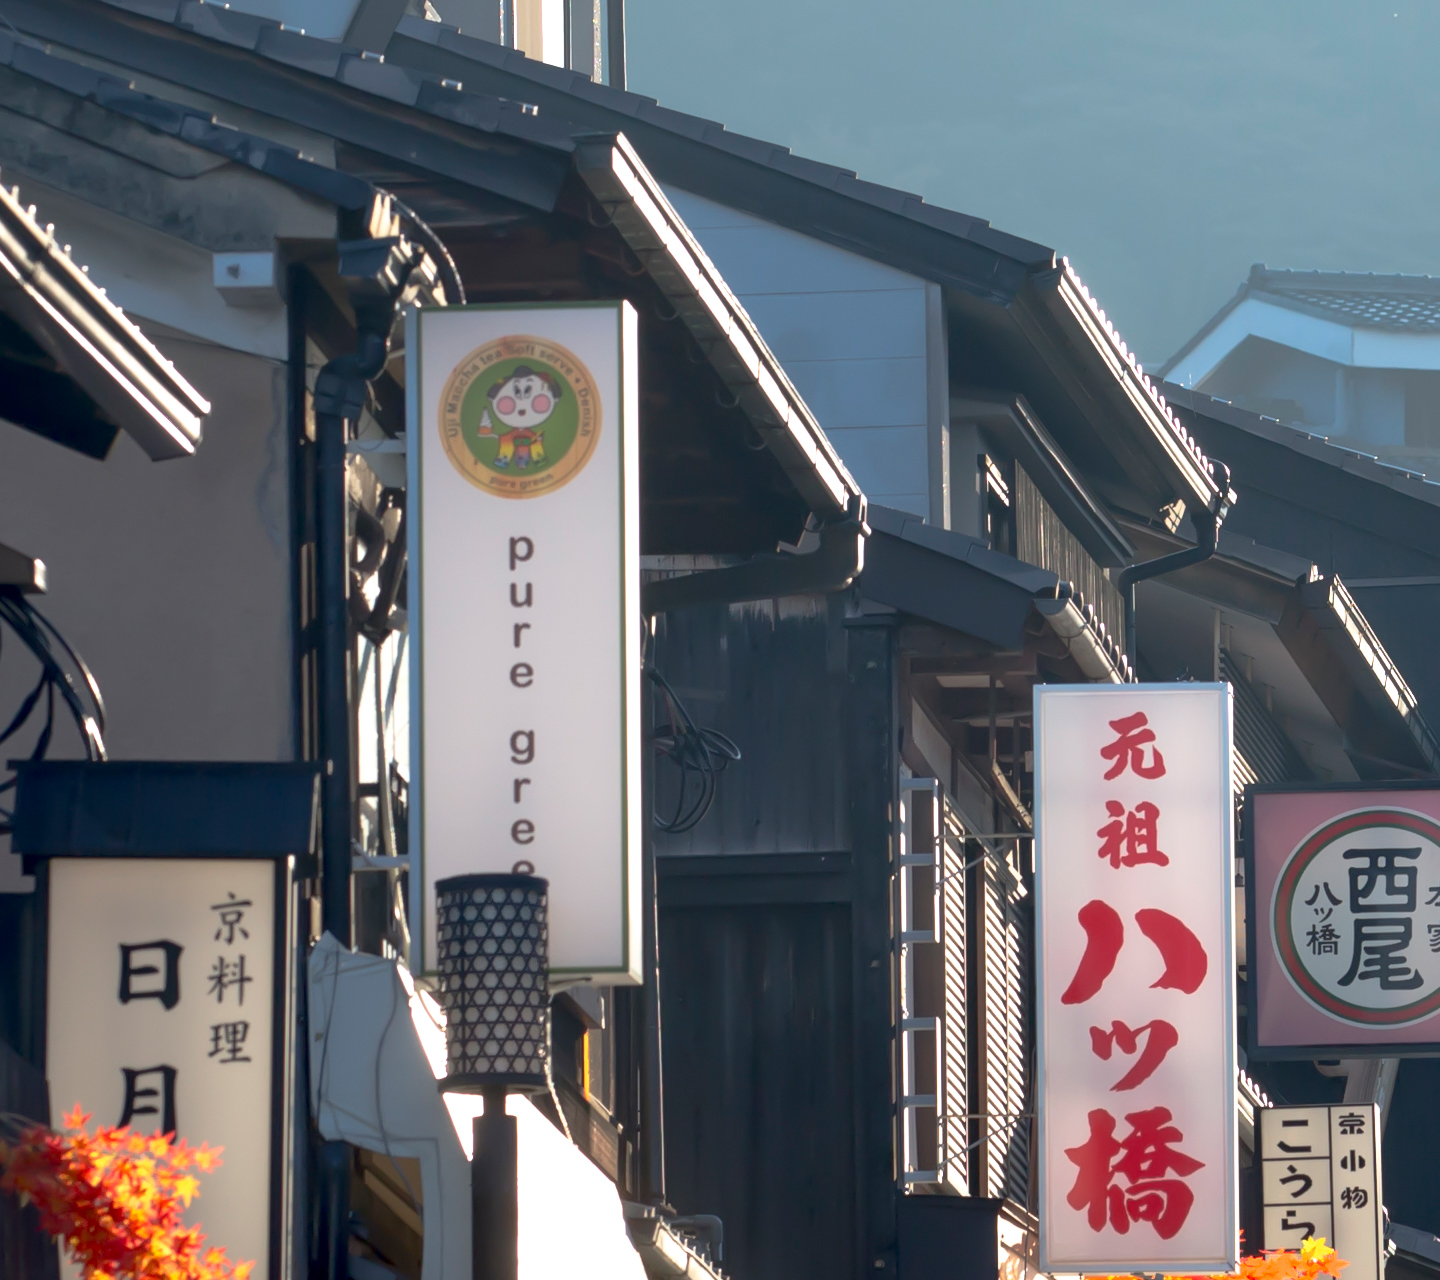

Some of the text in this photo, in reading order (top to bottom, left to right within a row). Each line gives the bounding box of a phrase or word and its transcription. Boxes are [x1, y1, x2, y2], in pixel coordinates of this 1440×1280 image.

[509, 535, 536, 876] pure gree
[207, 892, 254, 1064] 京料理
[1337, 847, 1424, 991] 西尾
[118, 939, 184, 1146] 日月
[1338, 1112, 1369, 1210] 京小物
